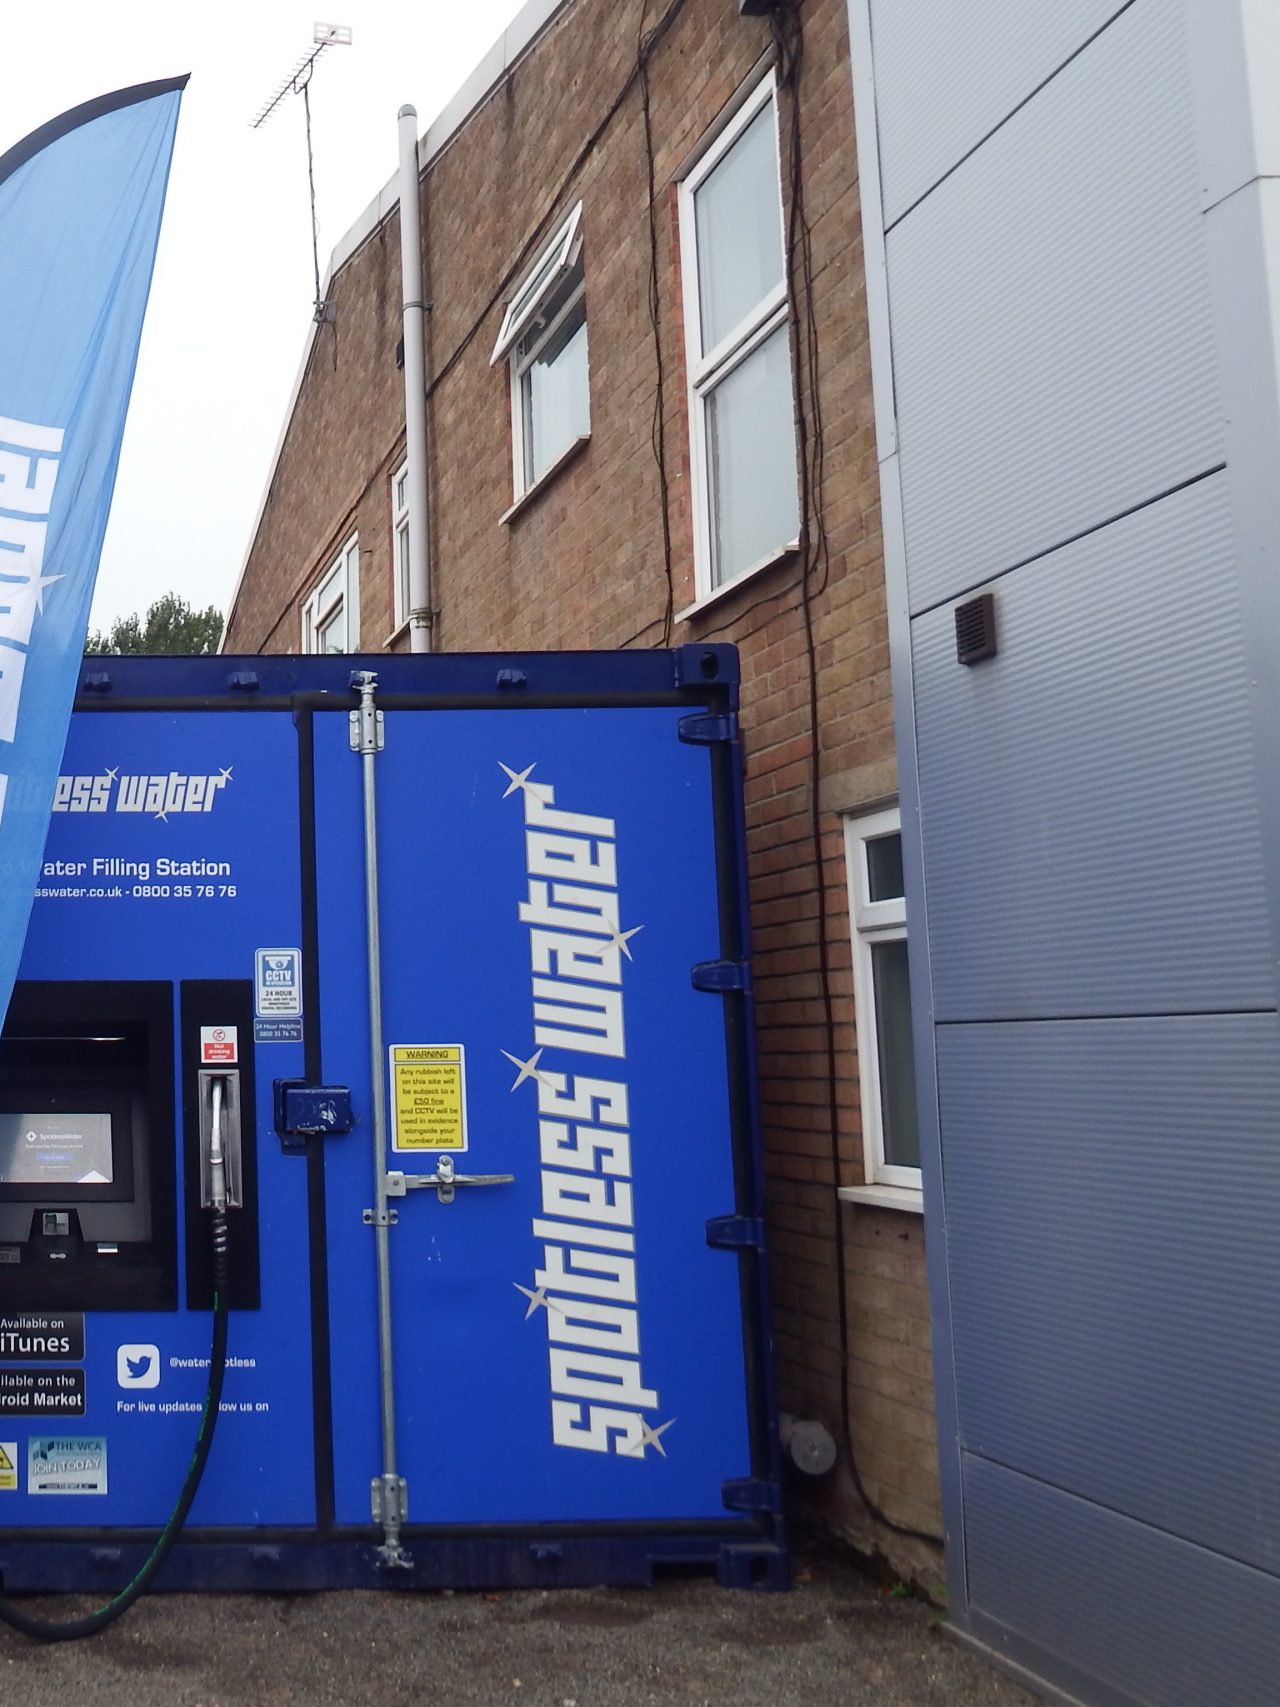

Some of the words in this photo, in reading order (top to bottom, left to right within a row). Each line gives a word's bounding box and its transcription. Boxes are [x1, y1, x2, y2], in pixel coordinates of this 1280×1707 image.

[116, 771, 227, 813] water
[43, 860, 87, 876] ater
[93, 858, 150, 880] Filling
[156, 858, 231, 876] Station
[34, 886, 122, 897] sswater.co.uk
[132, 885, 170, 897] 0800
[173, 885, 192, 897] 35
[195, 885, 214, 897] 76
[218, 885, 237, 897] 76
[518, 781, 625, 1059] water
[266, 970, 291, 981] CCTV
[406, 1050, 449, 1059] WARNING
[400, 1068, 413, 1076] Any
[413, 1088, 439, 1096] subject
[404, 1127, 438, 1135] alongside
[436, 1137, 454, 1145] plate
[532, 1069, 659, 1459] spotless
[0, 1318, 48, 1329] Available
[50, 1319, 64, 1329] on
[0, 1332, 70, 1353] iTunes
[37, 1376, 53, 1387] on
[56, 1374, 76, 1387] the
[33, 1392, 82, 1407] Market
[117, 1401, 135, 1412] For
[138, 1401, 156, 1412] live
[158, 1401, 203, 1415] updates
[218, 1401, 237, 1412] low
[239, 1402, 253, 1412] us
[255, 1403, 269, 1412] on
[56, 1441, 74, 1452] THE
[77, 1441, 102, 1452] WCA
[33, 1462, 59, 1475] JOIN
[61, 1457, 101, 1473] TODAY
